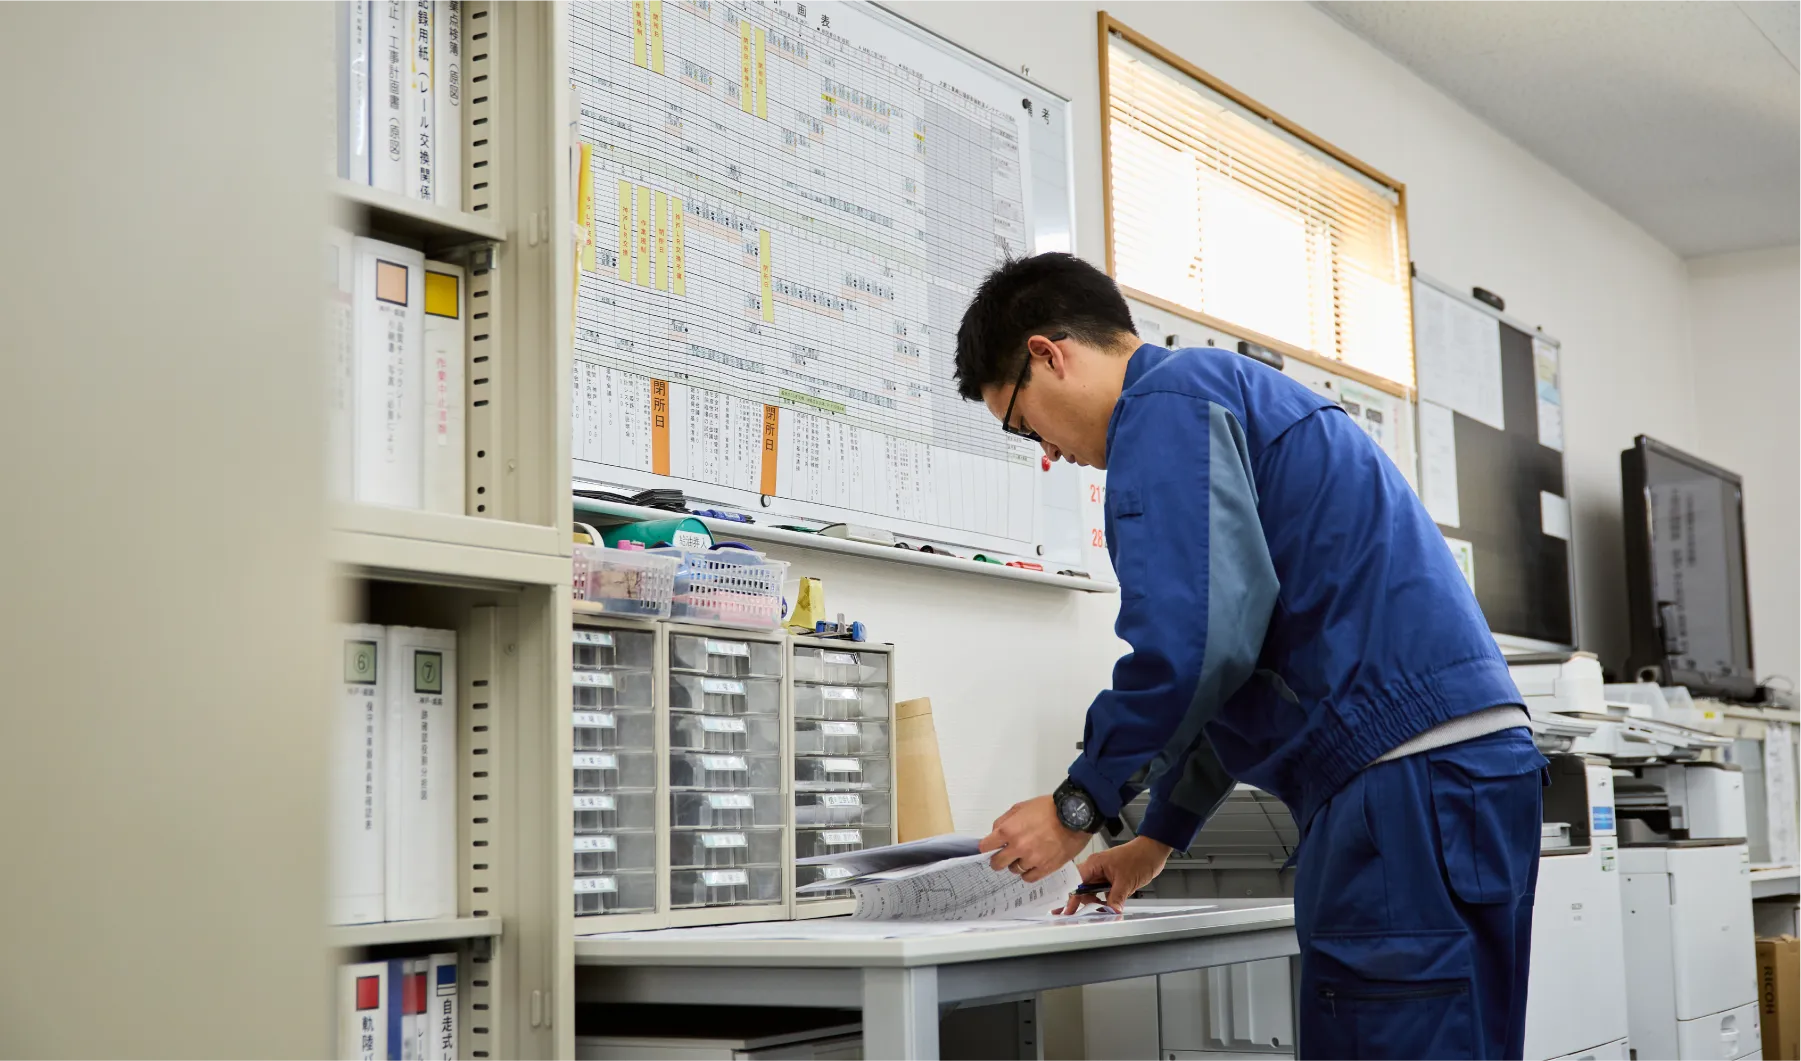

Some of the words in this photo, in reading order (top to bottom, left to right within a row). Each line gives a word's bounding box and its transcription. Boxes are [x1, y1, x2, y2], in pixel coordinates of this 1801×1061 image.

[653, 380, 666, 429] 閉所日
[765, 405, 776, 451] 閉所日
[1089, 484, 1101, 504] 21
[1092, 528, 1103, 548] 28
[1763, 965, 1776, 1014] RICOH
